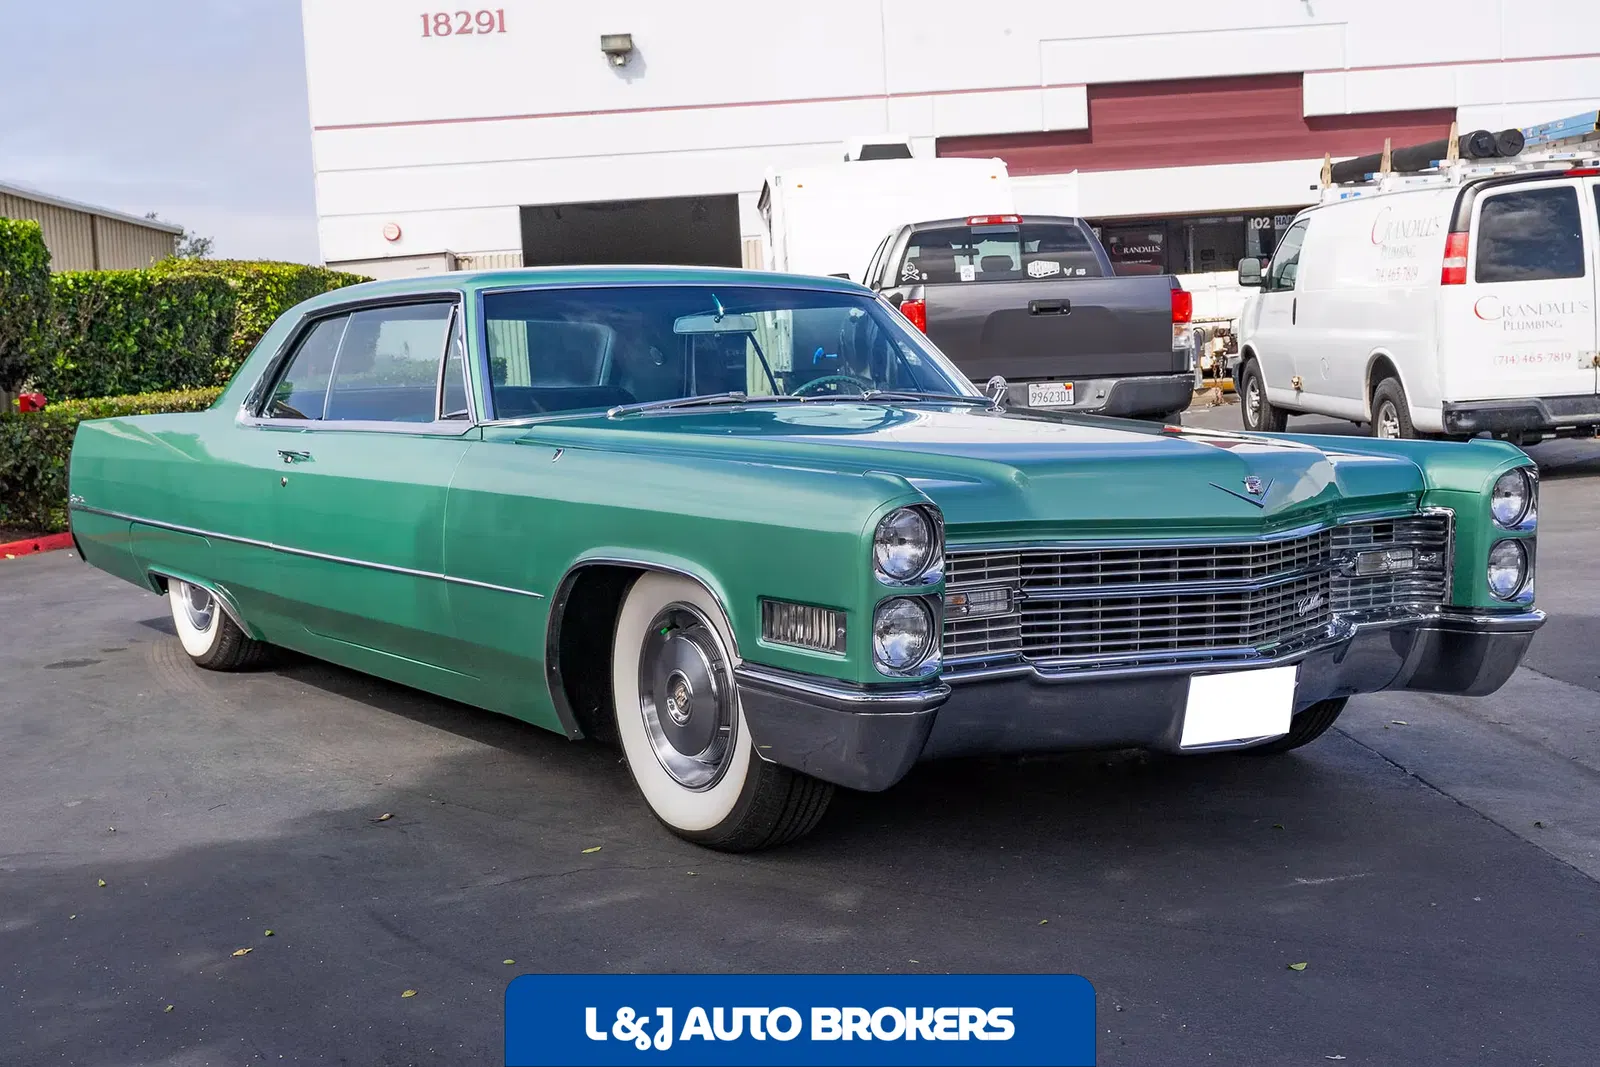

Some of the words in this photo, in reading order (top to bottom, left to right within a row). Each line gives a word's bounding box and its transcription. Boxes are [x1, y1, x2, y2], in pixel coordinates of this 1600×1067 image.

[420, 8, 507, 37] 18291
[1250, 217, 1271, 229] 102
[1473, 295, 1589, 321] CRANDALL'S
[1503, 319, 1563, 331] PLUMBING
